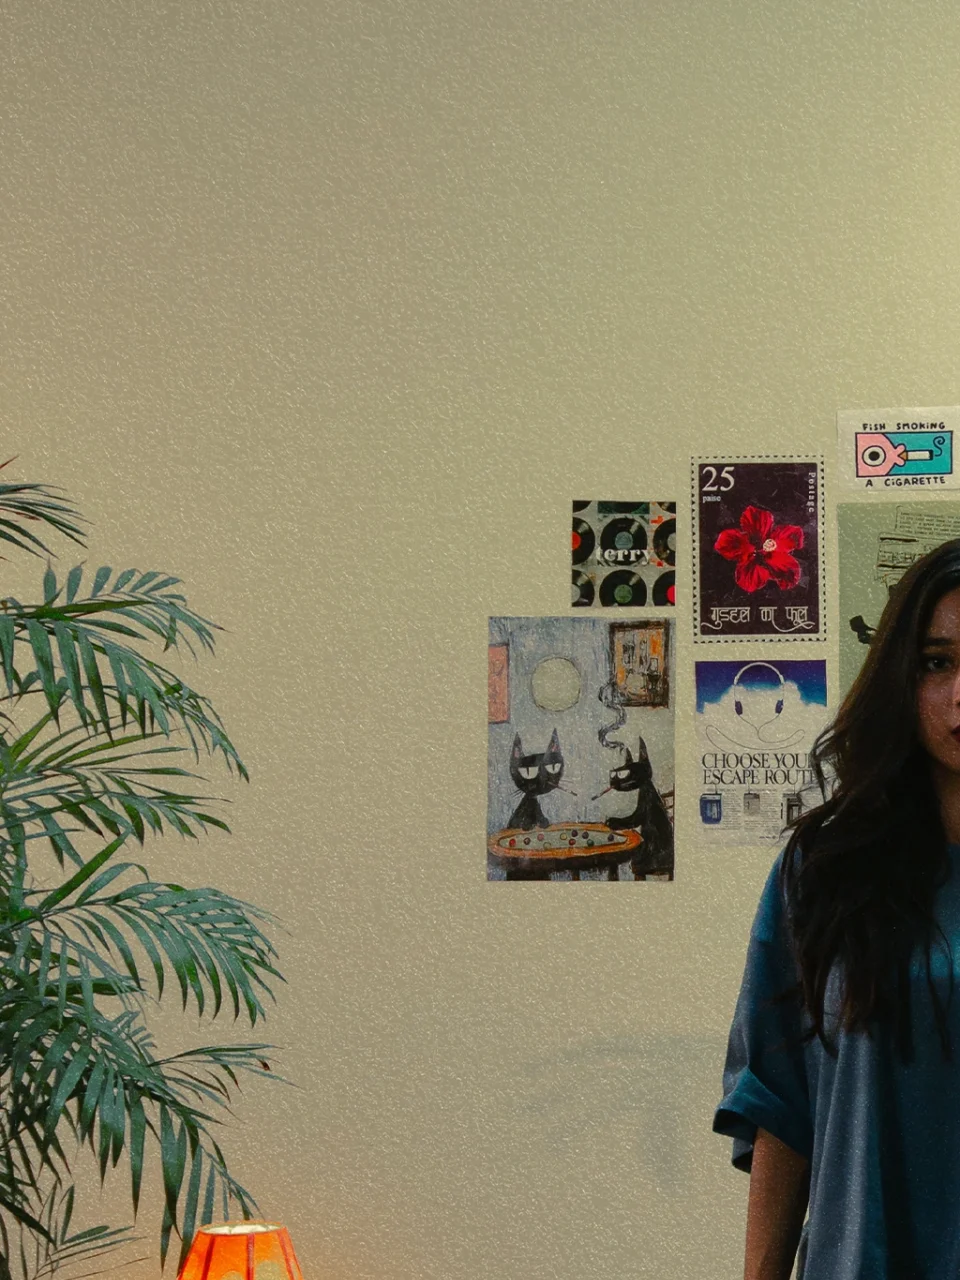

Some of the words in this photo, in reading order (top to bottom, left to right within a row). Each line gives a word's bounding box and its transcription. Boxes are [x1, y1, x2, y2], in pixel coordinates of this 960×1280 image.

[701, 466, 735, 492] 25
[865, 479, 874, 488] A
[807, 471, 817, 513] Postage
[701, 752, 772, 769] CHOOSE
[703, 769, 760, 785] ESCAPE
